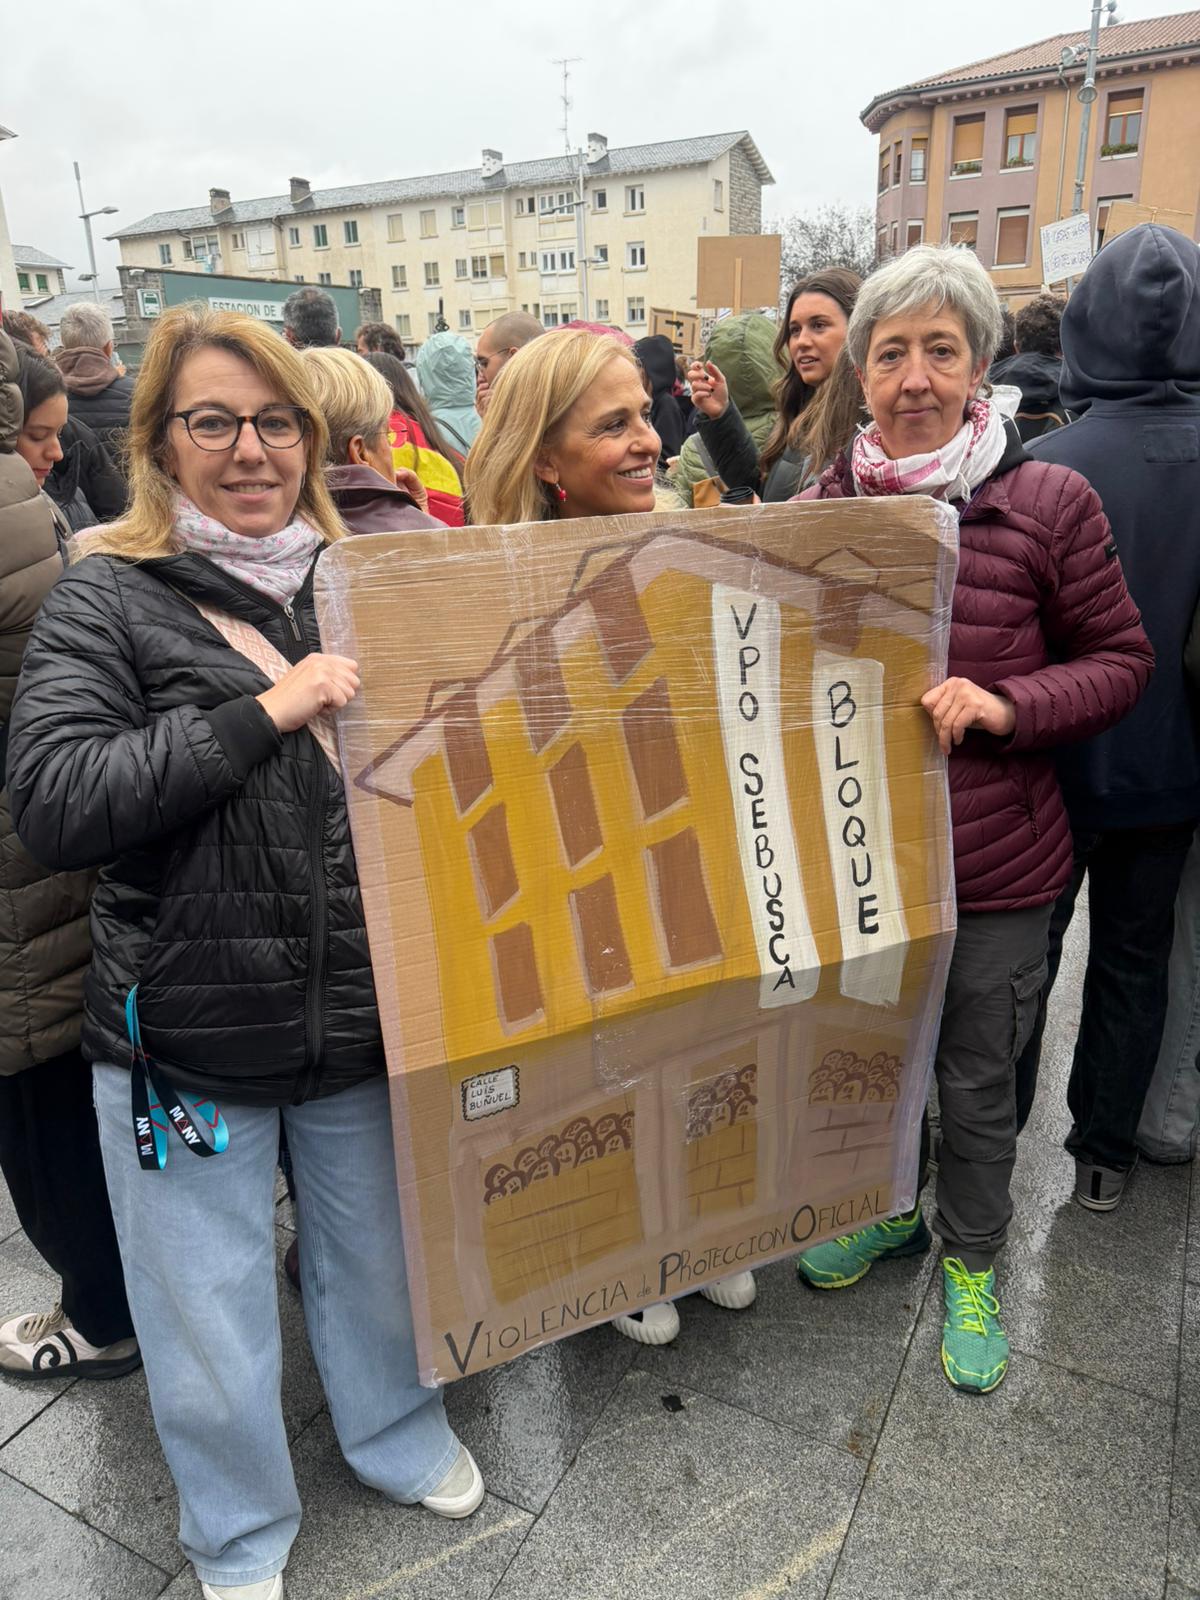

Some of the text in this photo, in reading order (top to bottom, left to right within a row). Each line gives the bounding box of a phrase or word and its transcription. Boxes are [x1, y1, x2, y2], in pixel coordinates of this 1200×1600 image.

[264, 304, 276, 316] DE
[730, 603, 760, 721] VPO
[827, 680, 880, 935] BLOQUE
[469, 1093, 511, 1111] BUÑUEL
[471, 1075, 498, 1088] CALLE
[444, 1280, 629, 1375] VIOLENCIA
[636, 1273, 652, 1298] de
[790, 1190, 888, 1243] OFICIAL
